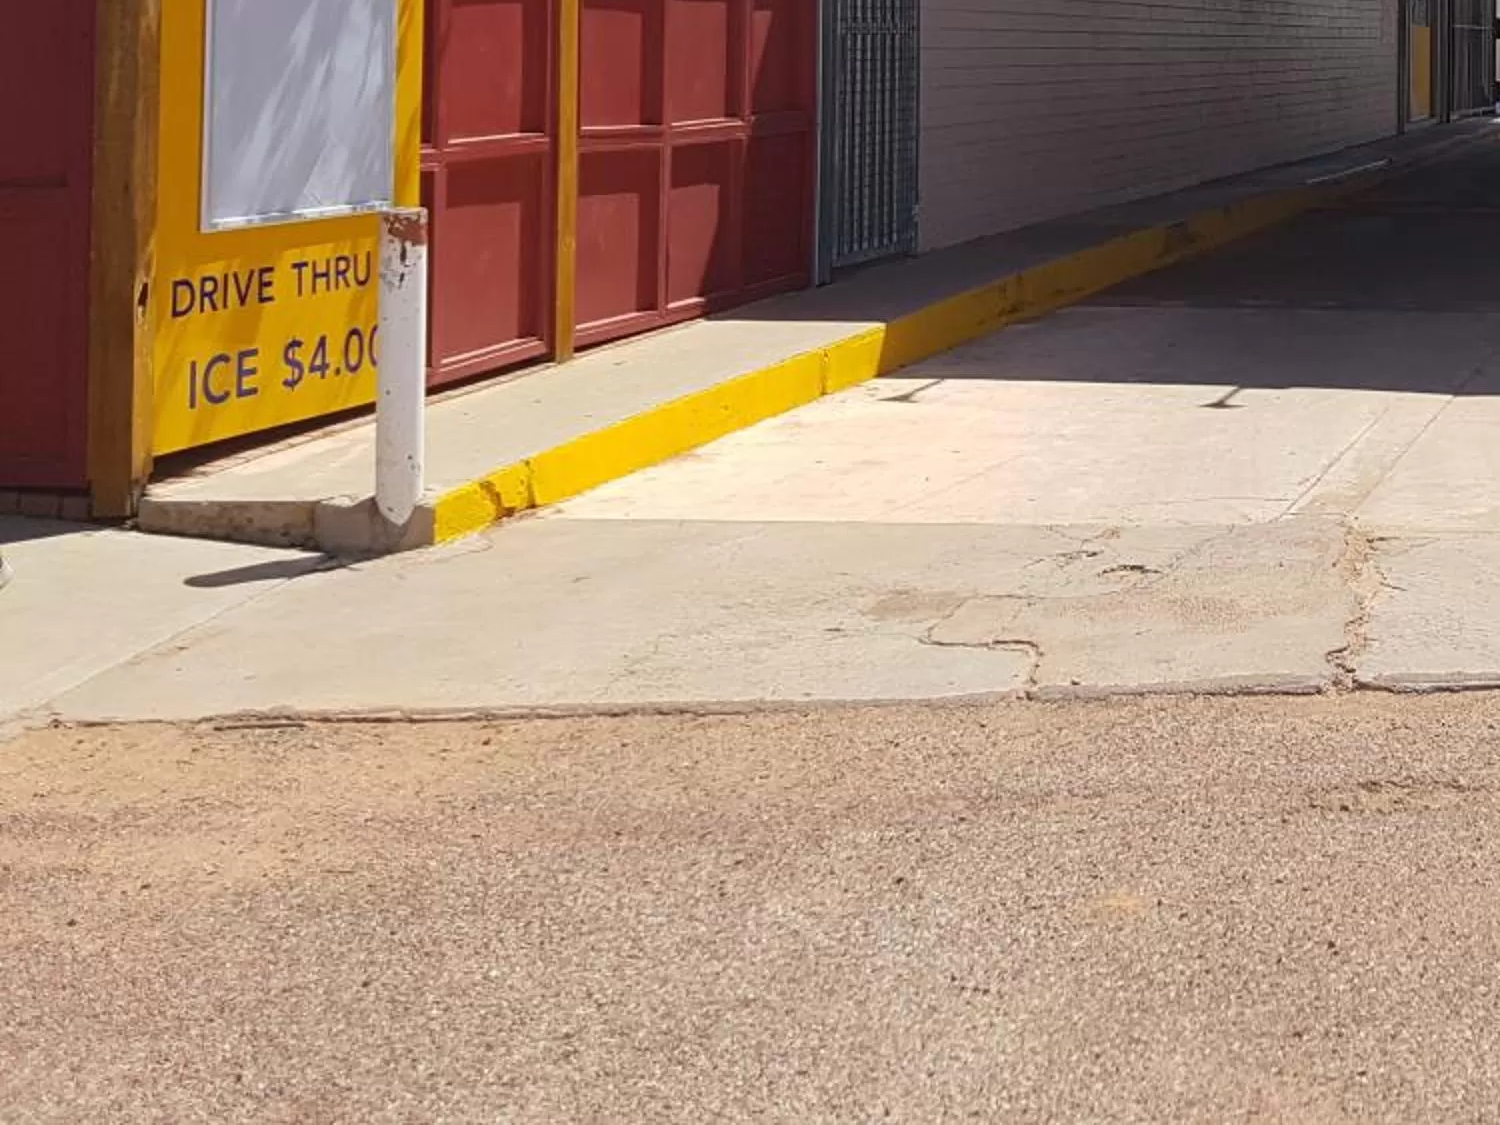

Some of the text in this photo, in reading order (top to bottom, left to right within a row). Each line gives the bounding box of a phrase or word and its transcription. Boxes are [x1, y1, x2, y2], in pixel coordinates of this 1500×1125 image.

[171, 250, 372, 318] DRIVE THRU
[188, 348, 259, 409] ICE
